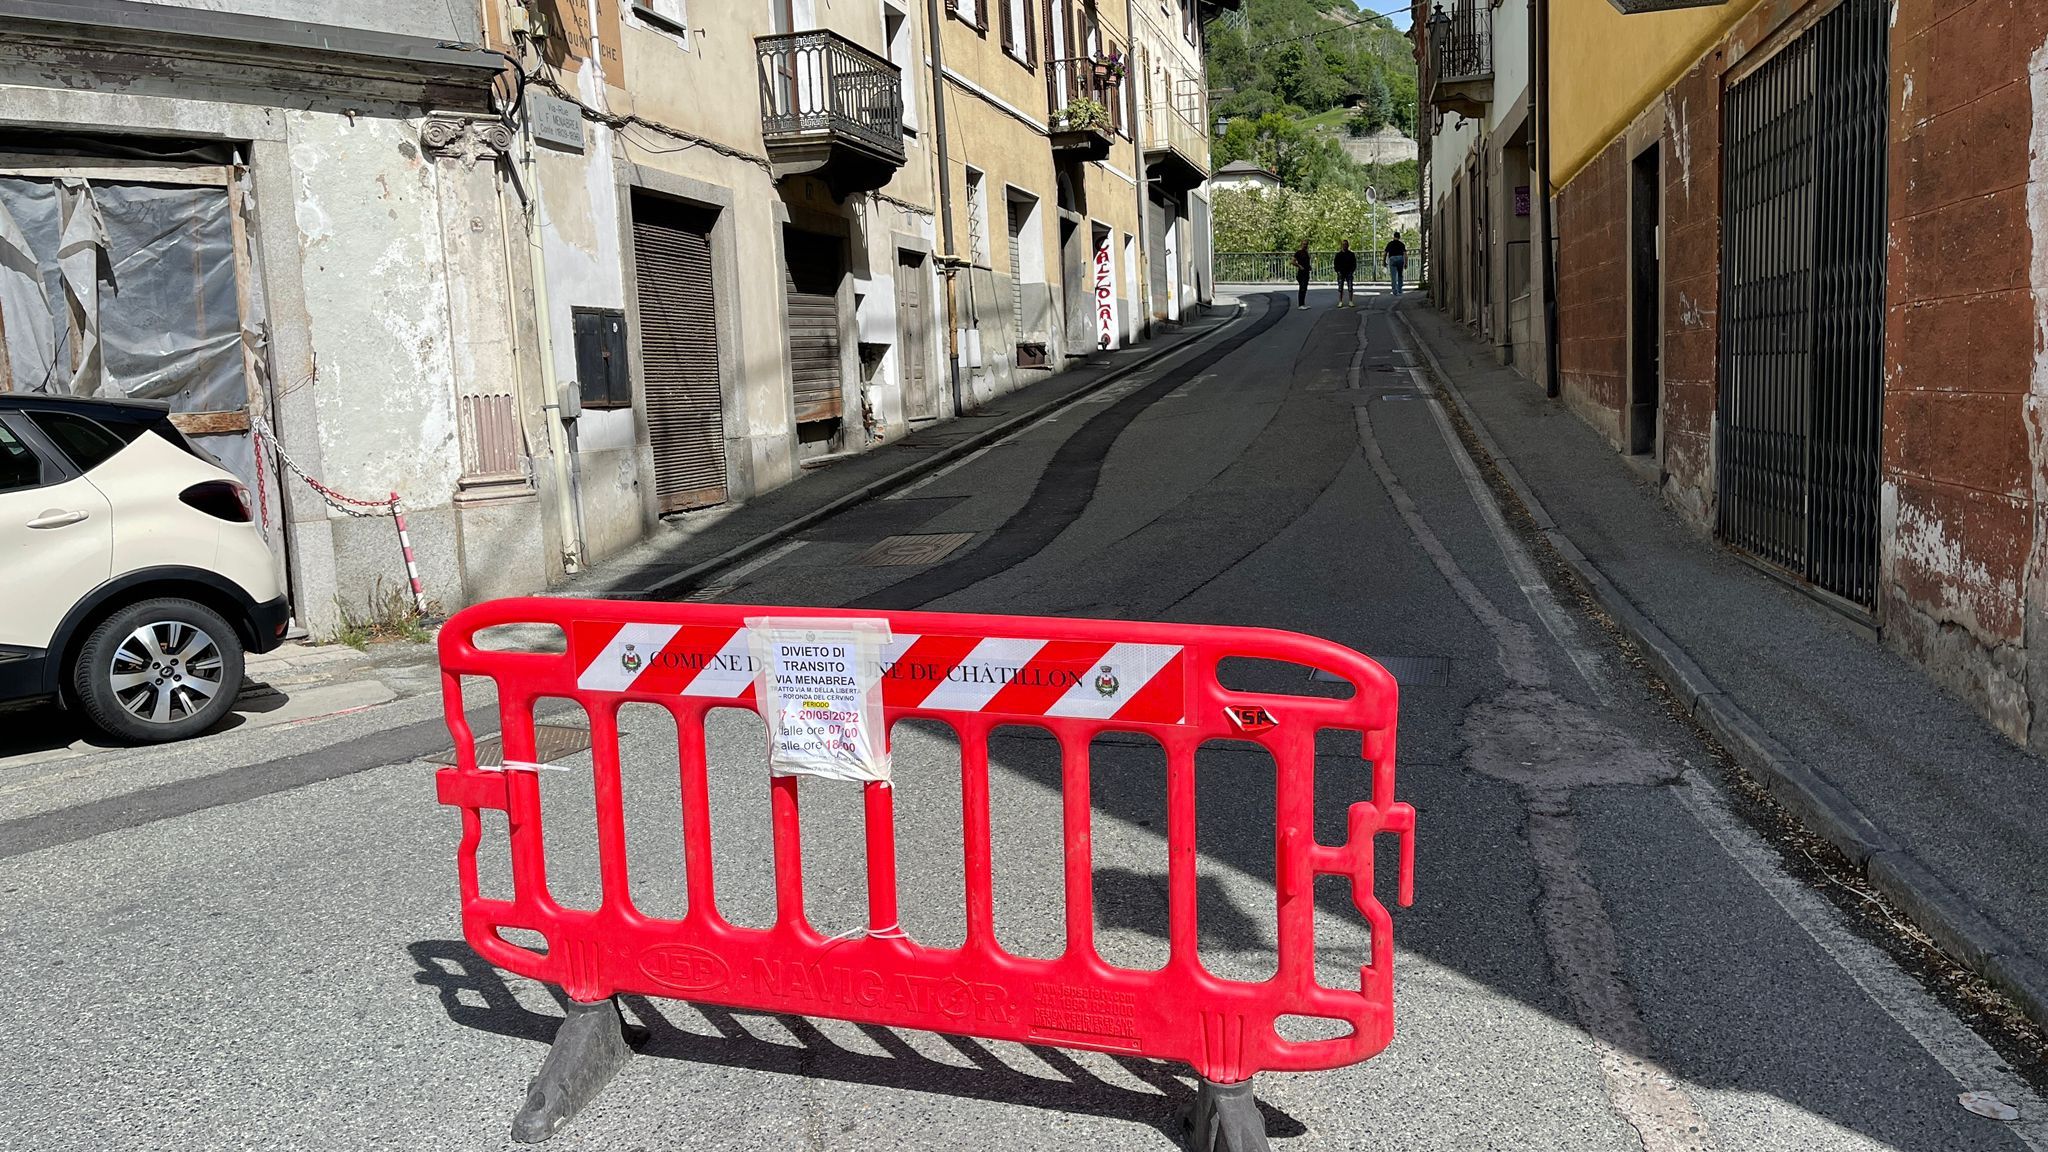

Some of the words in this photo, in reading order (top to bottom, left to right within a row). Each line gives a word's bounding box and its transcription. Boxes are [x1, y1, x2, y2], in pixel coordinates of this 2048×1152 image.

[552, 115, 579, 131] MENABREA
[1096, 236, 1112, 345] CALZOLAIO
[781, 646, 829, 657] DIVIETO
[833, 647, 845, 658] DI
[650, 651, 742, 671] COMUNE
[910, 663, 942, 682] DE
[946, 663, 1084, 688] CHÂTILLON
[784, 661, 845, 672] TRANSITO
[776, 675, 792, 684] VIA
[795, 676, 855, 685] MENABREA
[799, 711, 859, 722] 20/05/2022
[779, 725, 803, 735] dalle
[807, 727, 824, 735] ore
[781, 741, 800, 750] alle
[804, 741, 822, 750] ore
[652, 952, 714, 981] JSP
[753, 957, 1009, 1024] NAVIGATOR
